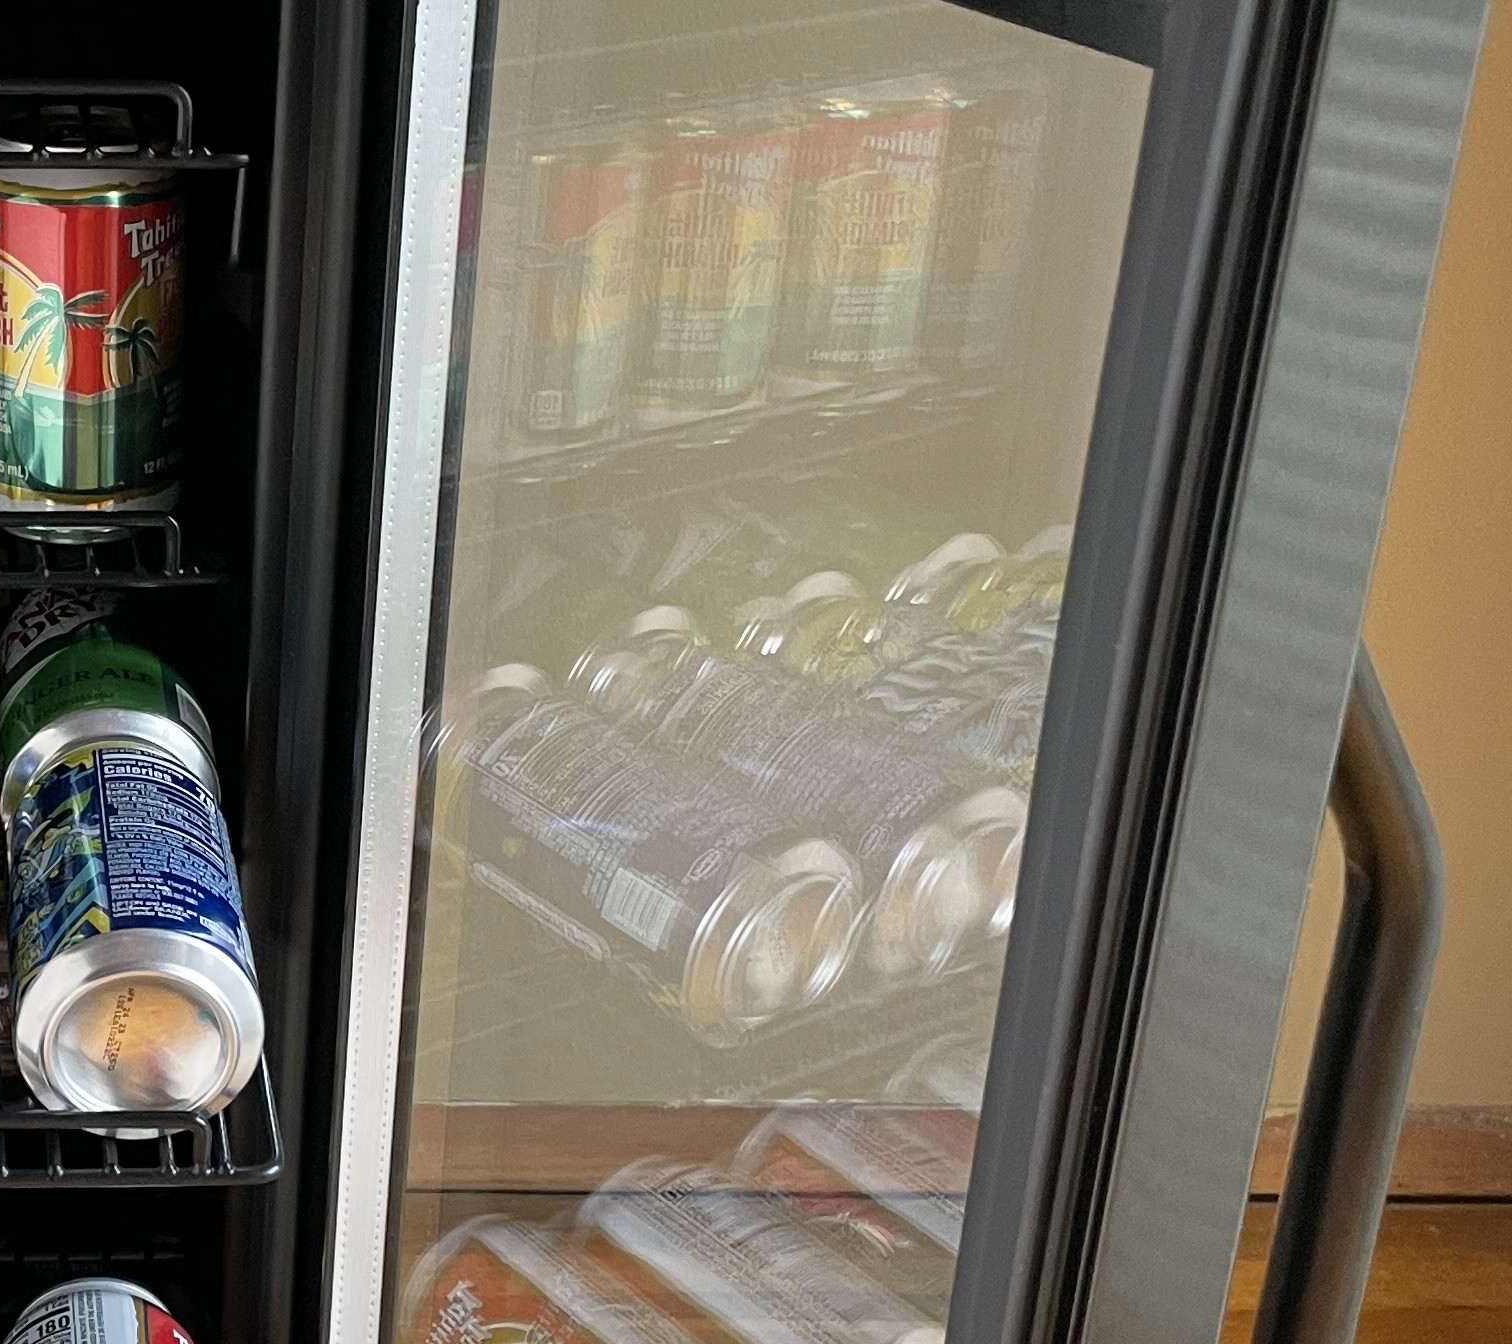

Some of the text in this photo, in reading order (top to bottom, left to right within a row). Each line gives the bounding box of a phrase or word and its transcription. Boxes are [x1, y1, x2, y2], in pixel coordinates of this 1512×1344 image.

[7, 461, 29, 480] mL)
[103, 765, 172, 783] Calories
[37, 1315, 71, 1338] 180
